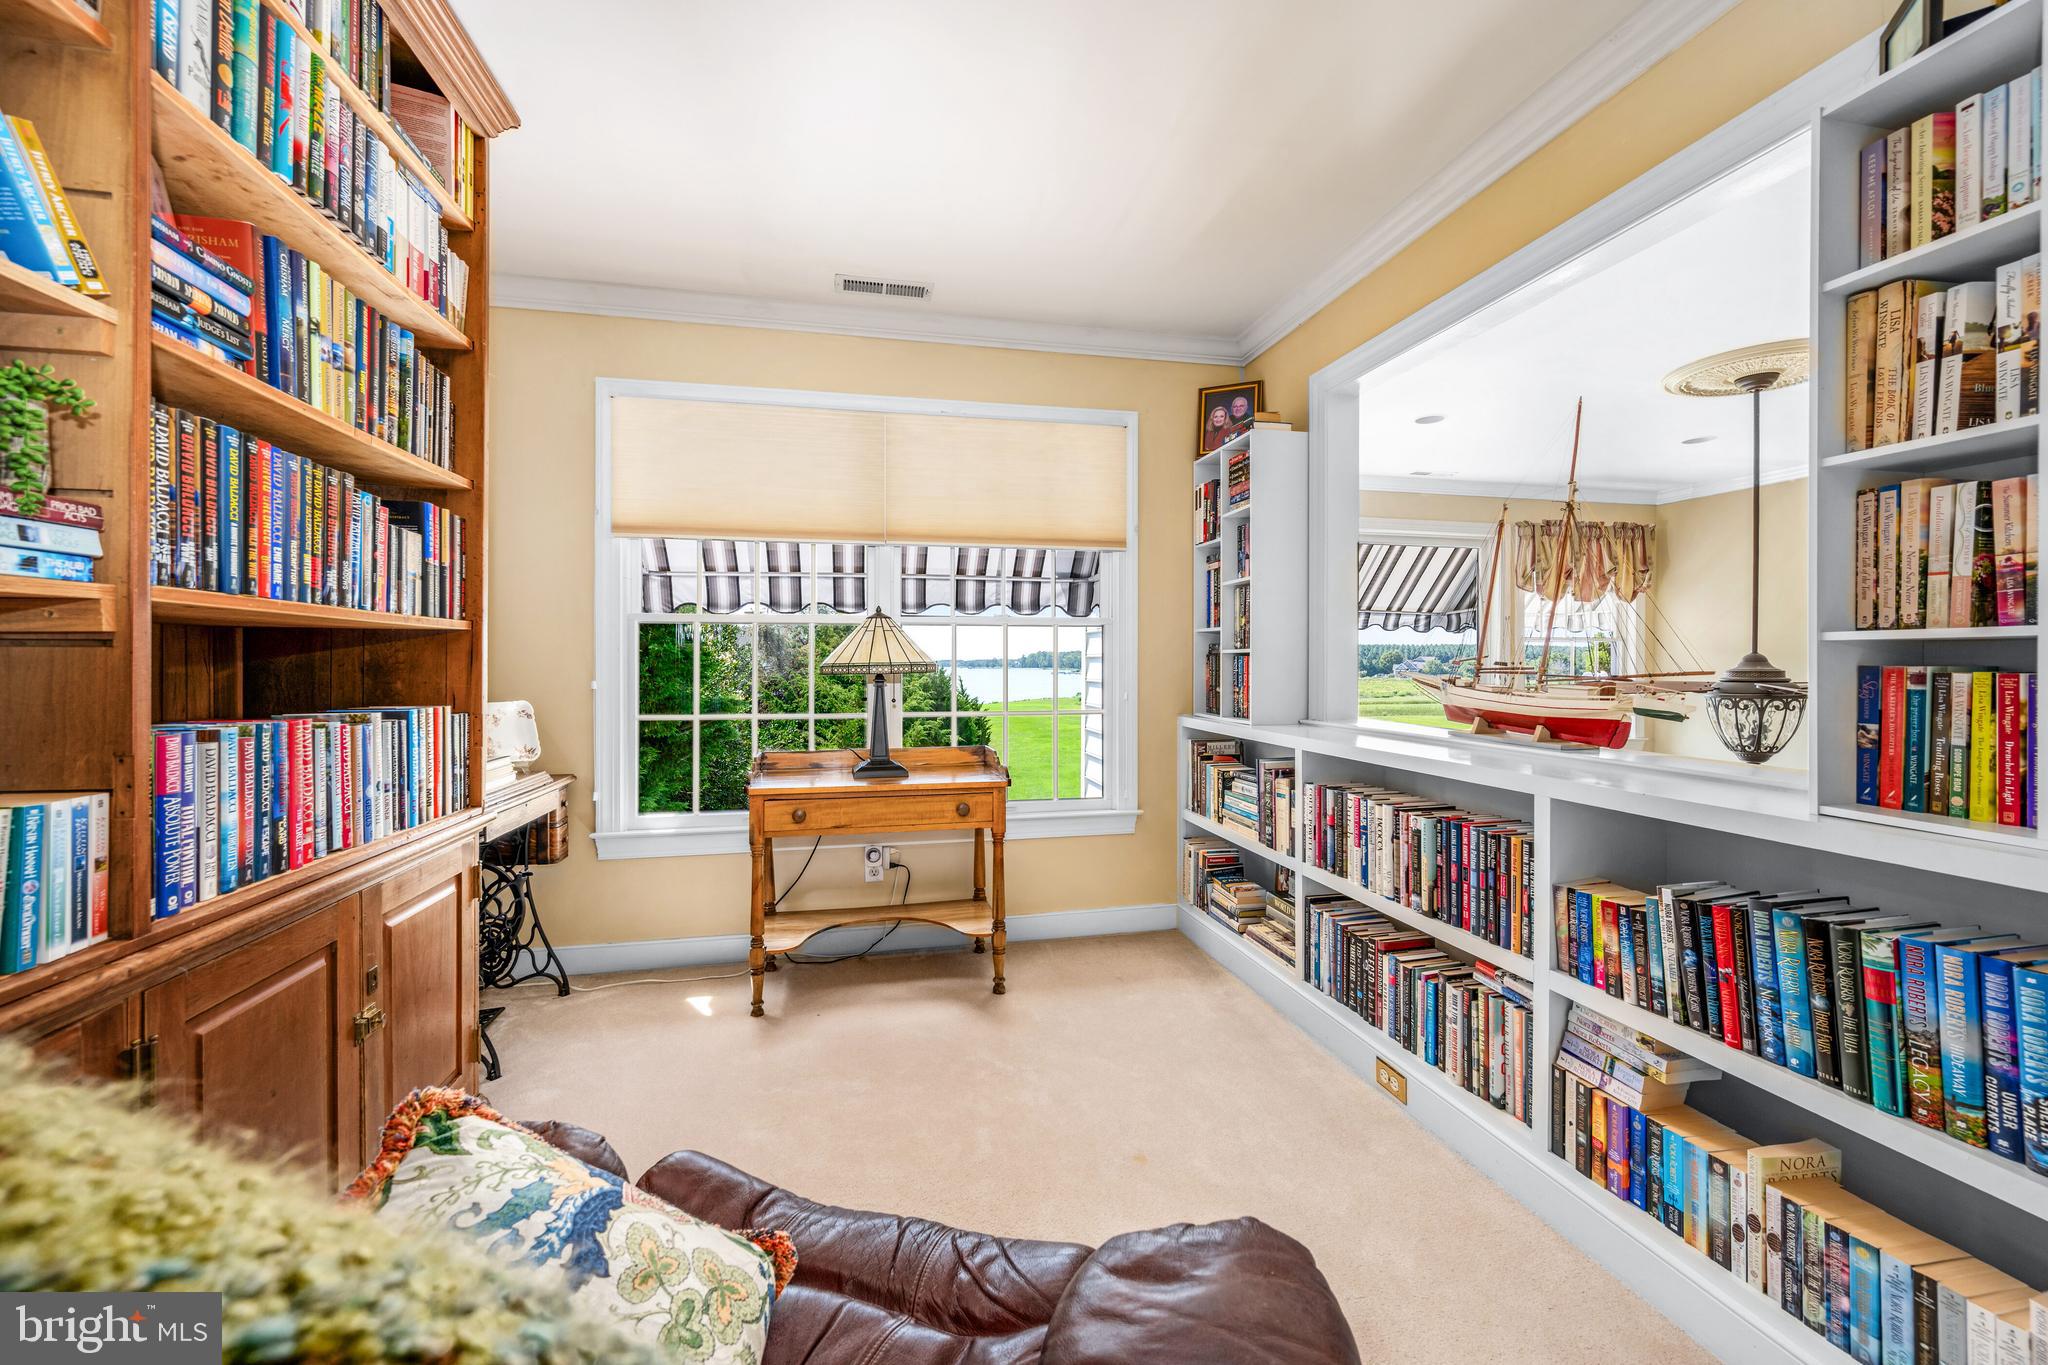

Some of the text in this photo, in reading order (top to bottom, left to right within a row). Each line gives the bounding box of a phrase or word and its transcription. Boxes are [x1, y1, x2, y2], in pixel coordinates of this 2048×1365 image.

[314, 85, 325, 135] MAZE
[311, 139, 320, 175] DEMILLE
[339, 164, 350, 210] CATHEDRAL
[52, 194, 77, 237] ARCHER
[196, 246, 252, 288] CAMINO GHOSTS
[280, 253, 288, 296] GRISHAM
[196, 316, 240, 345] JUDGE'S LIST
[281, 317, 290, 351] MERCY
[1878, 300, 1888, 350] WINGATE
[1889, 309, 1900, 334] LISA
[405, 377, 413, 419] GUARDIANS
[1885, 369, 1897, 423] THE BOOK OF
[1942, 376, 1953, 422] WINGATE
[1998, 360, 2008, 402] WINGATE
[2009, 368, 2020, 389] LISA
[1876, 391, 1884, 428] FRIENDS
[1917, 384, 1928, 430] WINGATE
[1968, 418, 1991, 427] LISA
[156, 424, 170, 534] DAVID BALDACCI
[181, 433, 195, 537] DAVID BALDACCI
[206, 440, 217, 536] DAVID BALDACCI
[230, 448, 239, 521] DAVID BALDACCI
[249, 455, 258, 525] DAVID BALDACCI
[313, 480, 322, 508] DAVID
[50, 500, 97, 516] PRIOR BAD
[63, 511, 87, 523] ACTS
[273, 452, 282, 584] DAVID BALDACCI END GAME
[313, 509, 322, 555] BALDACCI
[328, 486, 337, 566] DAVID BALDACCI
[1860, 500, 1872, 548] Lisa Wingate
[1880, 496, 1893, 545] Lisa Wingate
[1935, 495, 1944, 532] Dandelion
[1905, 551, 1915, 605] Never Say Never
[1954, 681, 1964, 739] LISA WINGATE
[2003, 706, 2014, 735] Wingate
[2005, 691, 2014, 704] Lisa
[165, 737, 179, 793] DAVID BALDACCI
[1933, 689, 1946, 796] Lisa Wingate Tending Roses
[2005, 741, 2014, 776] Drenched
[205, 749, 215, 843] DAVID BALDACCI
[228, 733, 237, 813] DAVID BALDACCI
[245, 741, 254, 819] DAVID BALDACCI
[303, 724, 313, 823] DAVID BALDACCI
[343, 762, 351, 814] BALDACCI
[1953, 765, 1962, 792] HOPE ROAD
[2003, 786, 2014, 805] Light
[164, 797, 181, 887] ABSOLUTE POWER
[181, 805, 194, 887] TOTAL CONTROL
[1680, 910, 1692, 948] NORA ROBERTS
[1753, 910, 1773, 982] NORA ROBERTS
[1777, 928, 1801, 995] NORA ROBERTS
[1807, 938, 1827, 996] NORA ROBERTS
[1836, 939, 1858, 1002] NORA ROBERTS
[1905, 944, 1928, 1029] NORA ROBERTS
[1759, 987, 1774, 1042] NIGHTWORK
[1813, 1009, 1830, 1033] THREE
[1942, 955, 1967, 1041] NORA ROBERTS
[1984, 972, 2012, 1069] NORA ROBERTS
[1842, 1015, 1859, 1054] THE VILLA
[2019, 986, 2048, 1085] NORA ROBERTS
[1908, 1039, 1931, 1104] LEGACY
[1950, 1043, 1967, 1097] HIDEAWAY
[1985, 1075, 2000, 1134] CURRENTS
[2000, 1091, 2018, 1130] UNDER
[2023, 1104, 2037, 1142] PLACE
[1780, 1155, 1826, 1171] NORA
[1787, 1211, 1796, 1261] NORA ROBERTS
